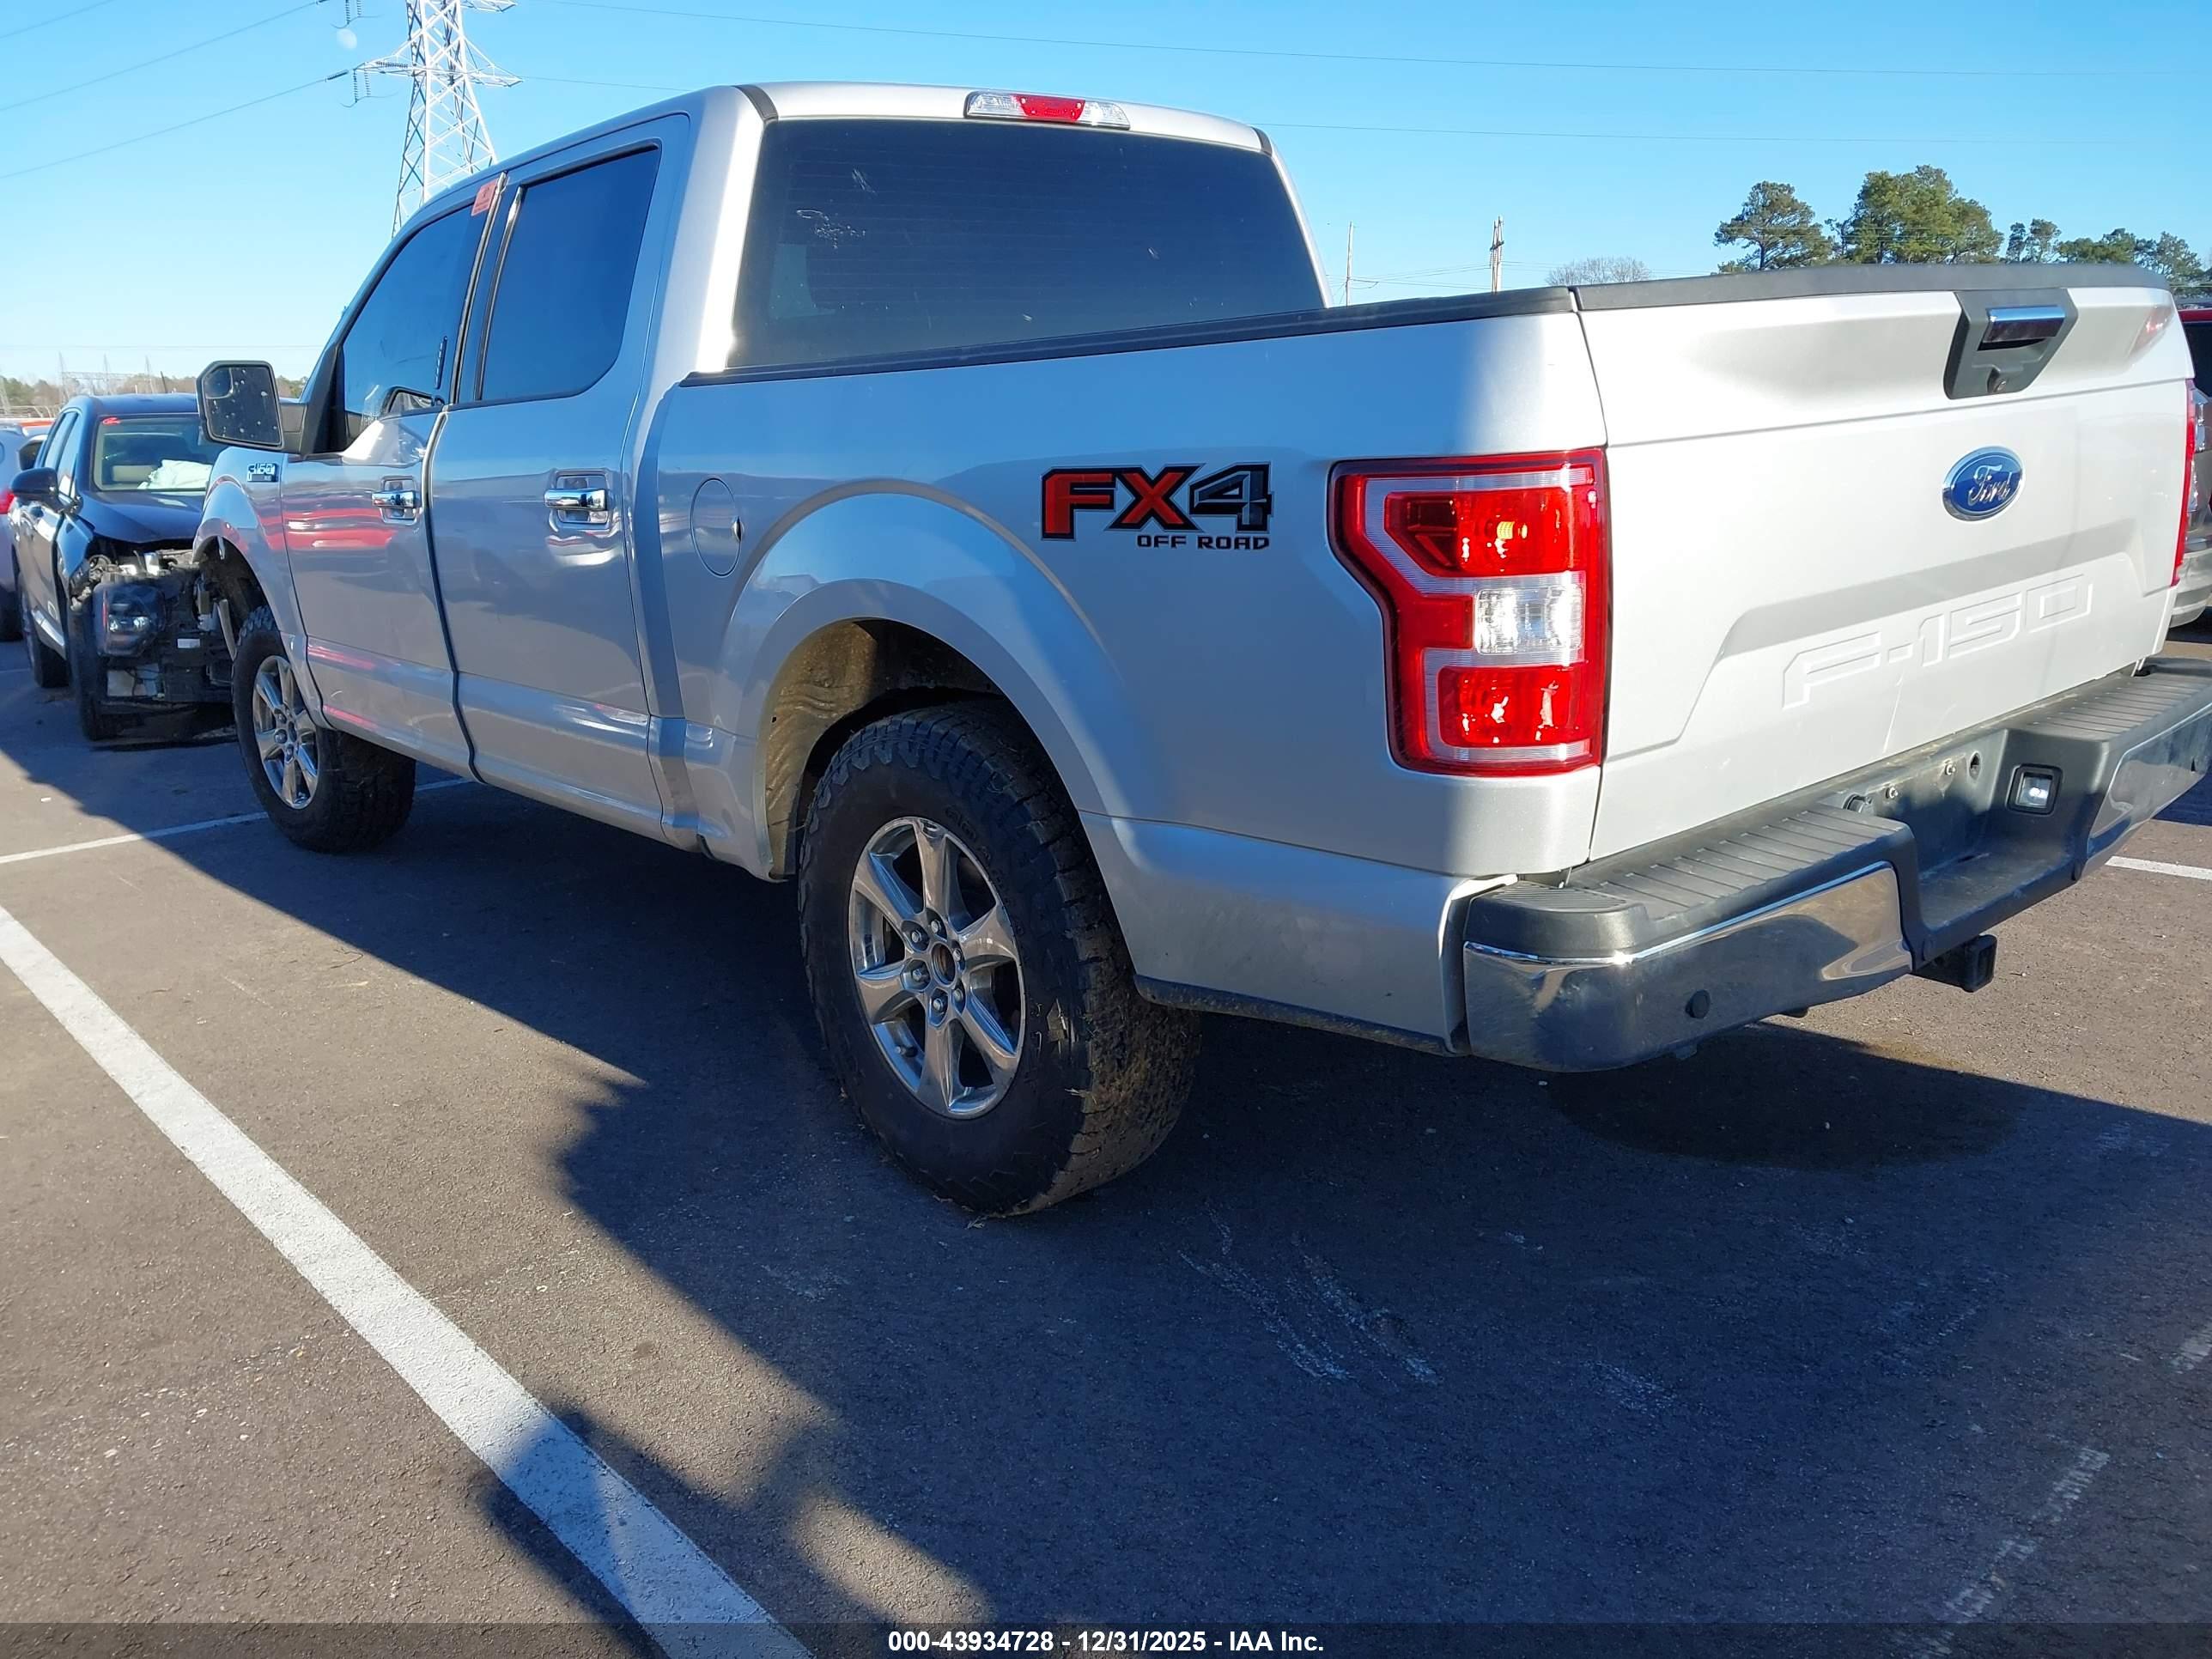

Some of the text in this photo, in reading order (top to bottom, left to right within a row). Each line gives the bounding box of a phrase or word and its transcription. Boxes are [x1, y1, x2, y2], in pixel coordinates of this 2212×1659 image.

[1041, 462, 1274, 541] FX4
[1967, 465, 2013, 507] Ford
[1137, 535, 1270, 550] OFF ROAD
[1782, 574, 2093, 710] F-150
